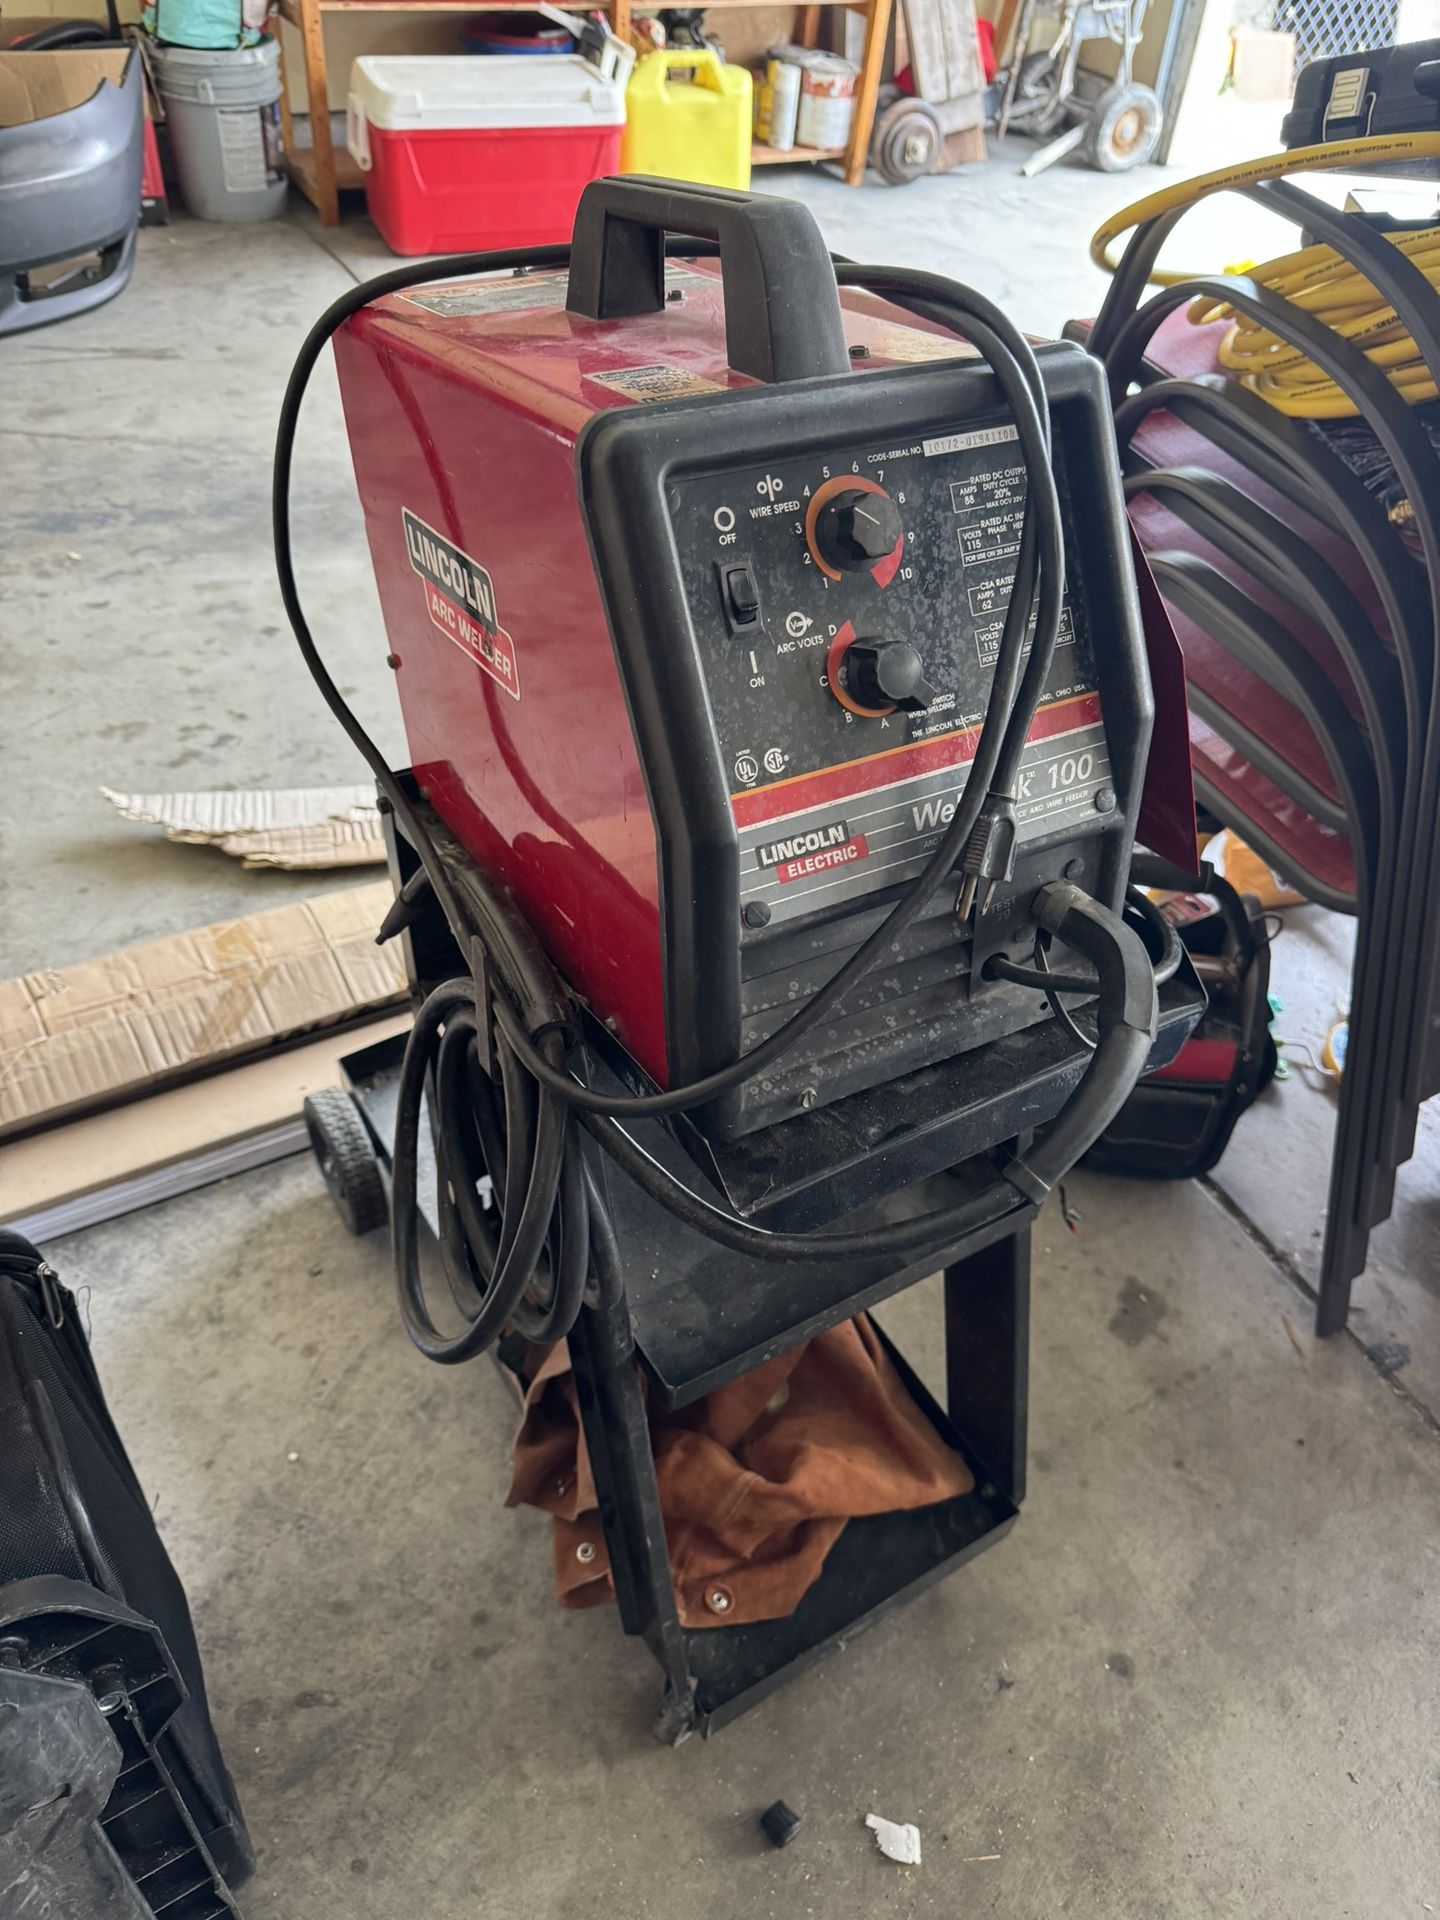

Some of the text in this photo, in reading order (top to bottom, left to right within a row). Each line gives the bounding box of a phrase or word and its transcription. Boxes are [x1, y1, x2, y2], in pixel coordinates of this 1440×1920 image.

[867, 448, 910, 463] CODE-SERIAL
[910, 446, 924, 456] NO.
[822, 466, 830, 478] 5
[852, 461, 860, 473] 6
[877, 470, 884, 482] 7
[970, 466, 1026, 484] RATED DC OUTPU
[803, 485, 811, 497] 4
[960, 476, 1020, 496] AMPS DUTY CYCLE
[898, 492, 906, 504] 8
[964, 487, 1011, 505] 88 20%
[749, 501, 800, 519] WIRE SPEED
[980, 518, 1001, 529] RATED
[1002, 514, 1014, 524] AC
[795, 523, 803, 535] 3
[963, 529, 982, 540] VOLTS
[987, 523, 1007, 534] PHASE
[719, 533, 737, 546] OFF
[907, 531, 915, 544] 9
[967, 539, 981, 551] 115
[996, 534, 1001, 544] 1
[804, 553, 812, 564] 2
[965, 554, 976, 563] FOR
[407, 523, 493, 622] LINCOLN
[900, 568, 913, 581] 10
[823, 577, 829, 589] 1
[980, 580, 995, 591] CSA
[977, 590, 995, 601] AMPS
[431, 593, 456, 630] ARC
[982, 600, 993, 610] 62
[828, 625, 837, 636] D
[989, 621, 1004, 631] CSA
[979, 631, 999, 642] VOLTS
[776, 635, 824, 655] ARC VOLTS
[983, 640, 998, 652] 115
[750, 677, 765, 688] ON
[819, 675, 829, 687] C
[932, 693, 955, 705] SWITCH
[907, 700, 955, 720] WHEN WELDING
[912, 729, 923, 738] THE
[925, 720, 953, 734] LINCOLN
[1055, 687, 1072, 698] OHIO
[1073, 684, 1086, 692] USA
[844, 711, 853, 724] B
[881, 718, 890, 729] A
[1048, 753, 1093, 790] 100
[1030, 804, 1044, 814] AND
[1046, 798, 1063, 810] WIRE
[1065, 790, 1089, 803] FEEDER
[760, 825, 846, 866] LINCOLN
[787, 845, 858, 878] ELECTRIC
